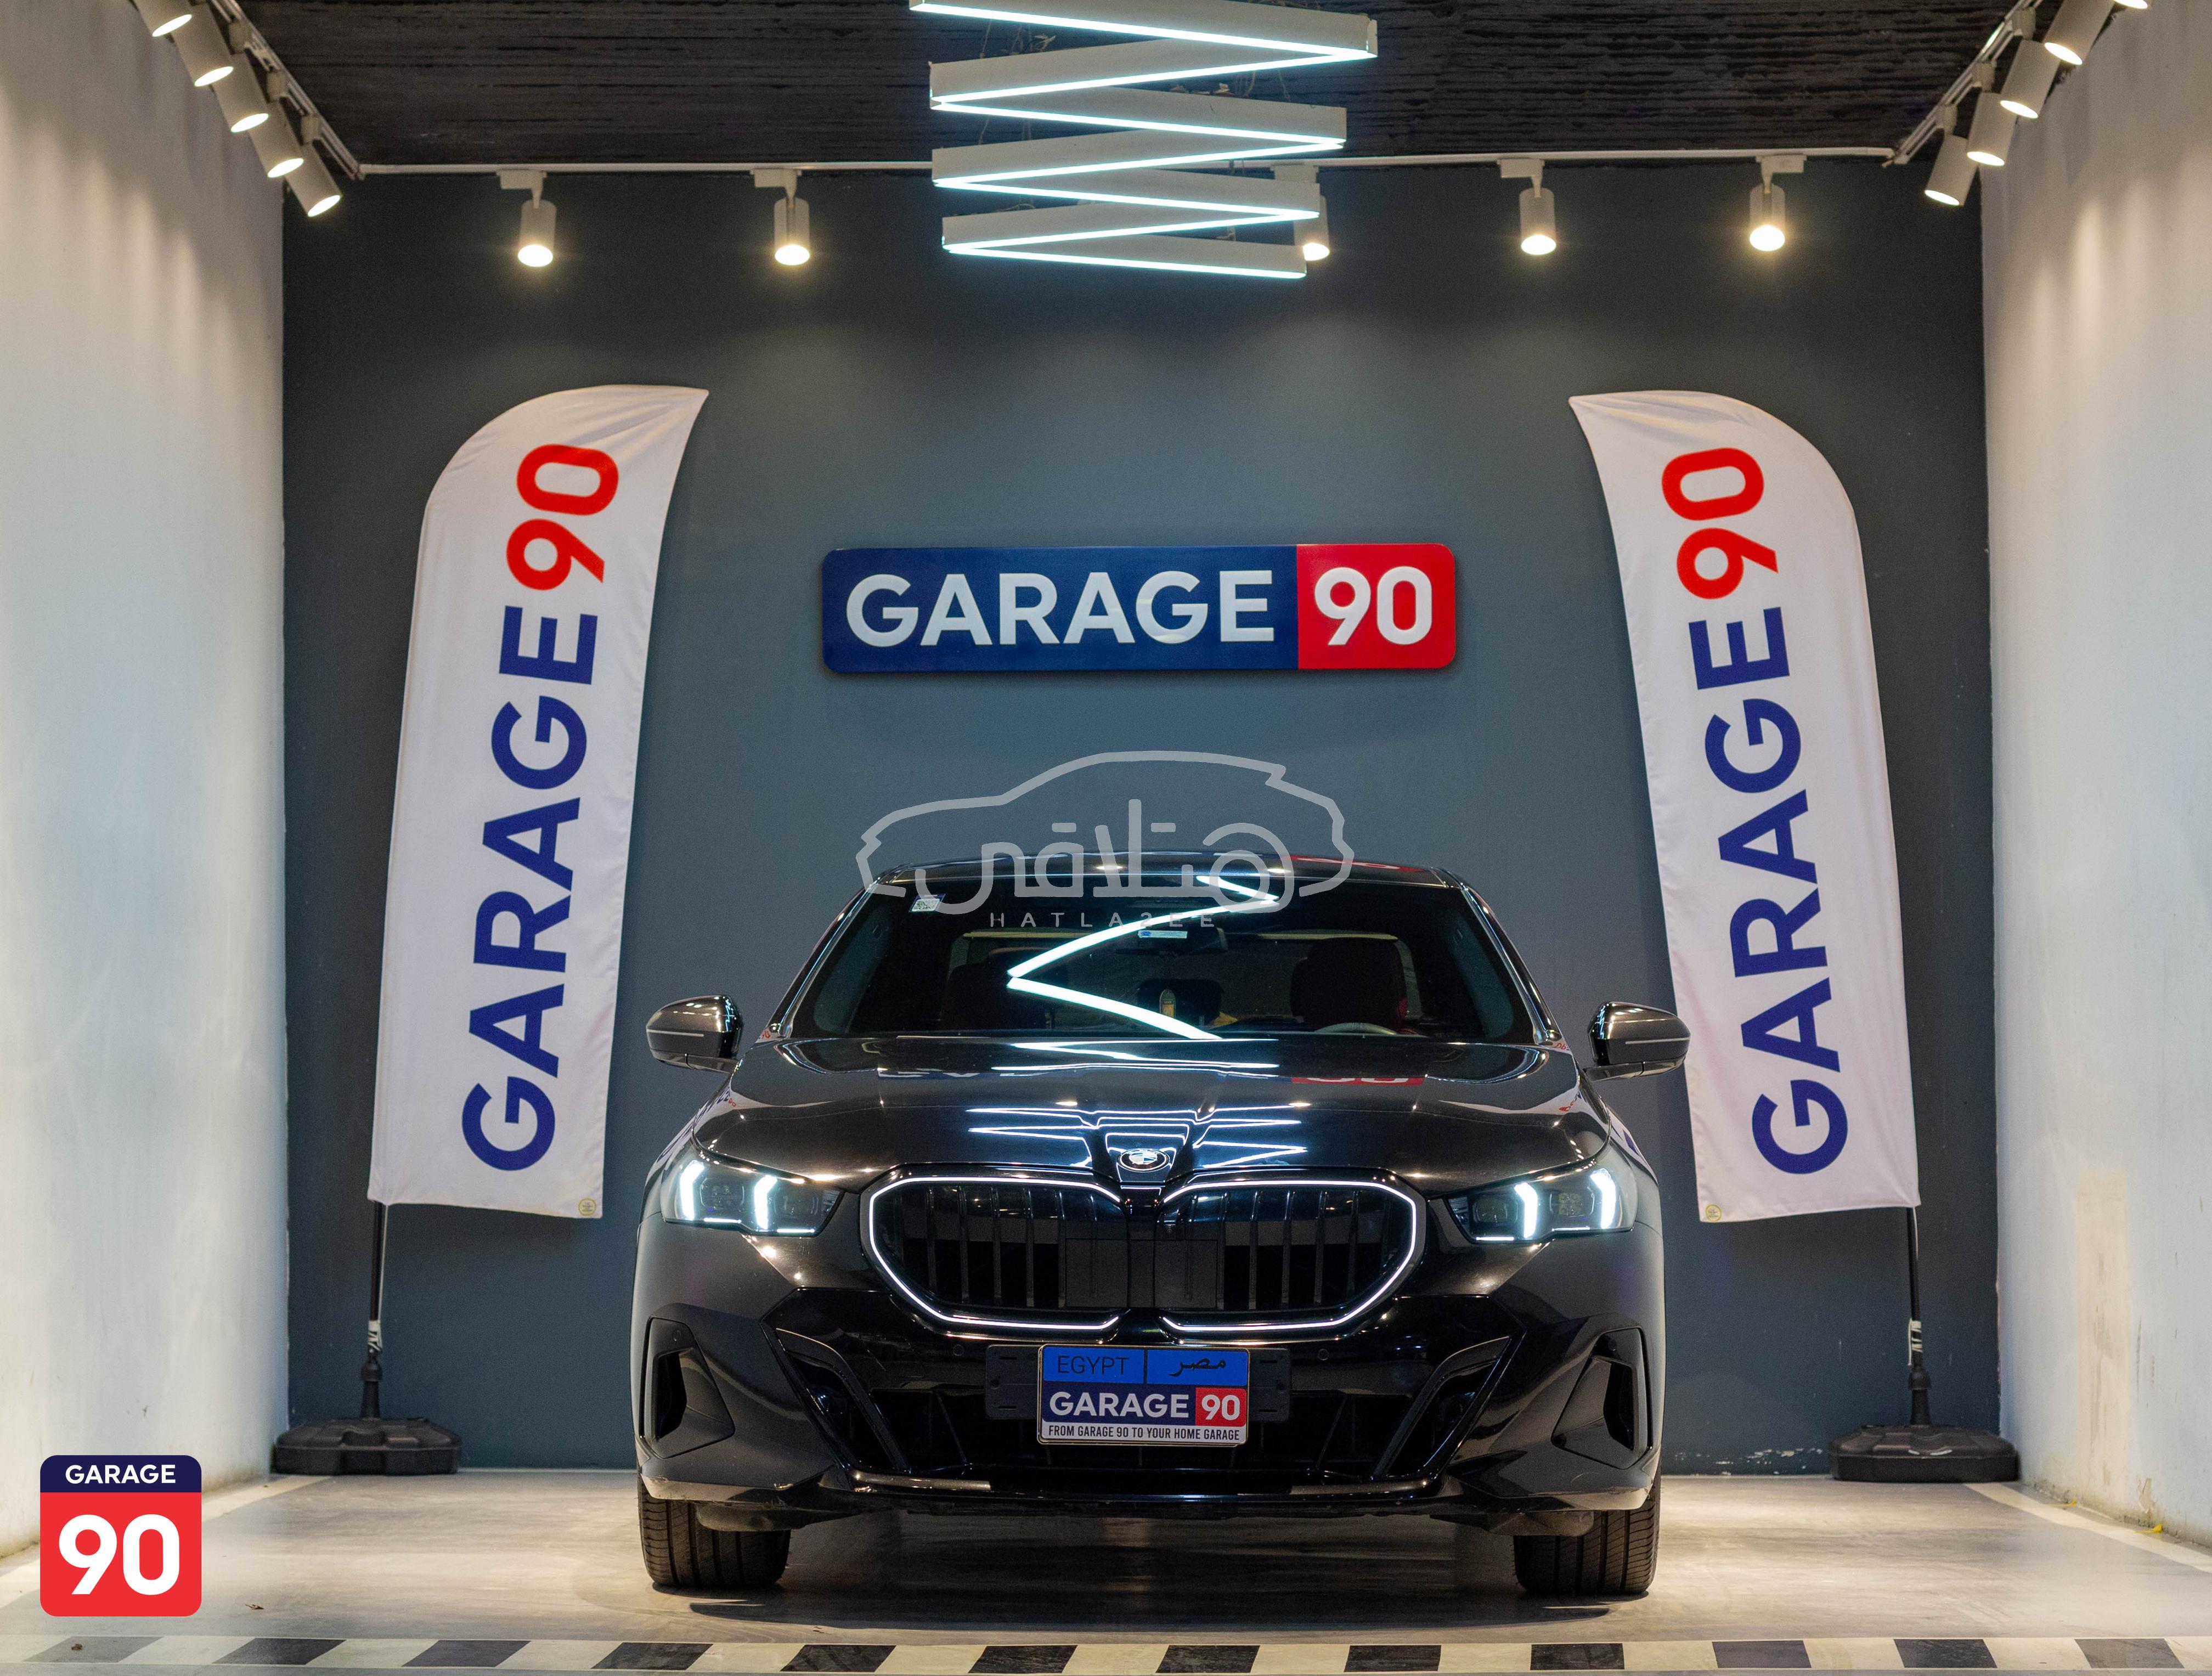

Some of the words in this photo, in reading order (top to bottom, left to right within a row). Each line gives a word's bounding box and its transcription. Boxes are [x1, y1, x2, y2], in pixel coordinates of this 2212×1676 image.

[506, 443, 619, 591] 90
[1661, 447, 1779, 600] 90
[847, 570, 1274, 647] GARAGE
[1314, 566, 1432, 646] 90
[462, 606, 597, 1171] GARAGE
[1689, 607, 1848, 1174] GARAGE
[1049, 1391, 1189, 1418] GARAGE
[1201, 1394, 1241, 1420] 90
[1057, 1355, 1130, 1375] EGYPT
[1169, 1356, 1227, 1376] مصر
[1048, 1425, 1074, 1436] FROM
[1077, 1426, 1114, 1437] GARAGE
[1116, 1427, 1128, 1437] 90
[1132, 1427, 1143, 1437] TO
[1147, 1427, 1171, 1438] YOUR
[1174, 1429, 1201, 1440] HOME
[1204, 1429, 1240, 1440] GARAGE
